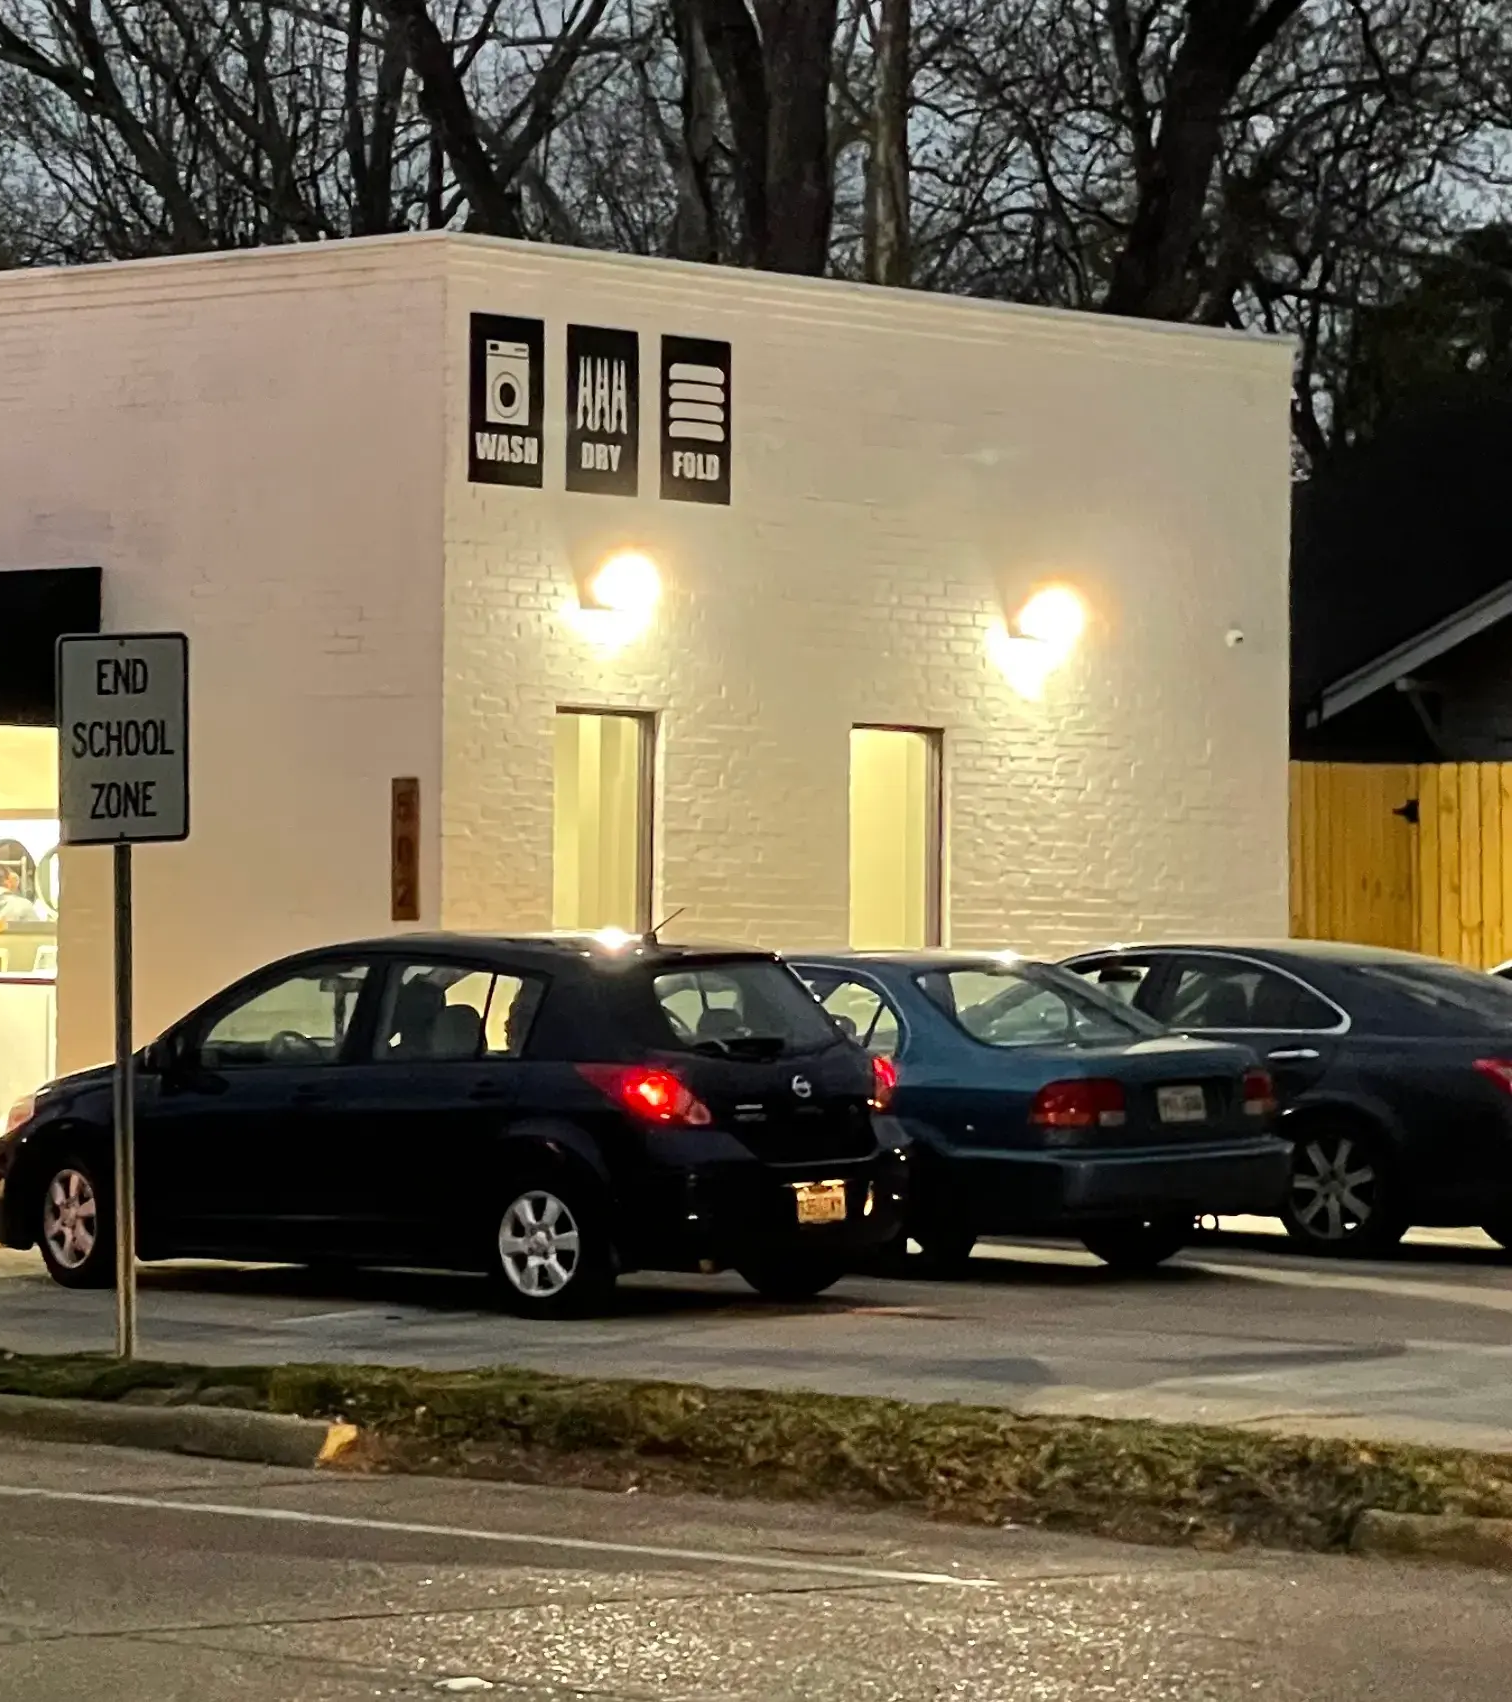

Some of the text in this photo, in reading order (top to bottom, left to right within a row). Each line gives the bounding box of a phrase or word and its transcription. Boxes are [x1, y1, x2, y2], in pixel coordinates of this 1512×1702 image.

[475, 432, 538, 464] WASH
[581, 442, 621, 471] DRY
[672, 451, 719, 480] FOLD
[96, 658, 148, 696] END
[71, 719, 174, 758] SCHOOL
[90, 781, 156, 819] ZONE
